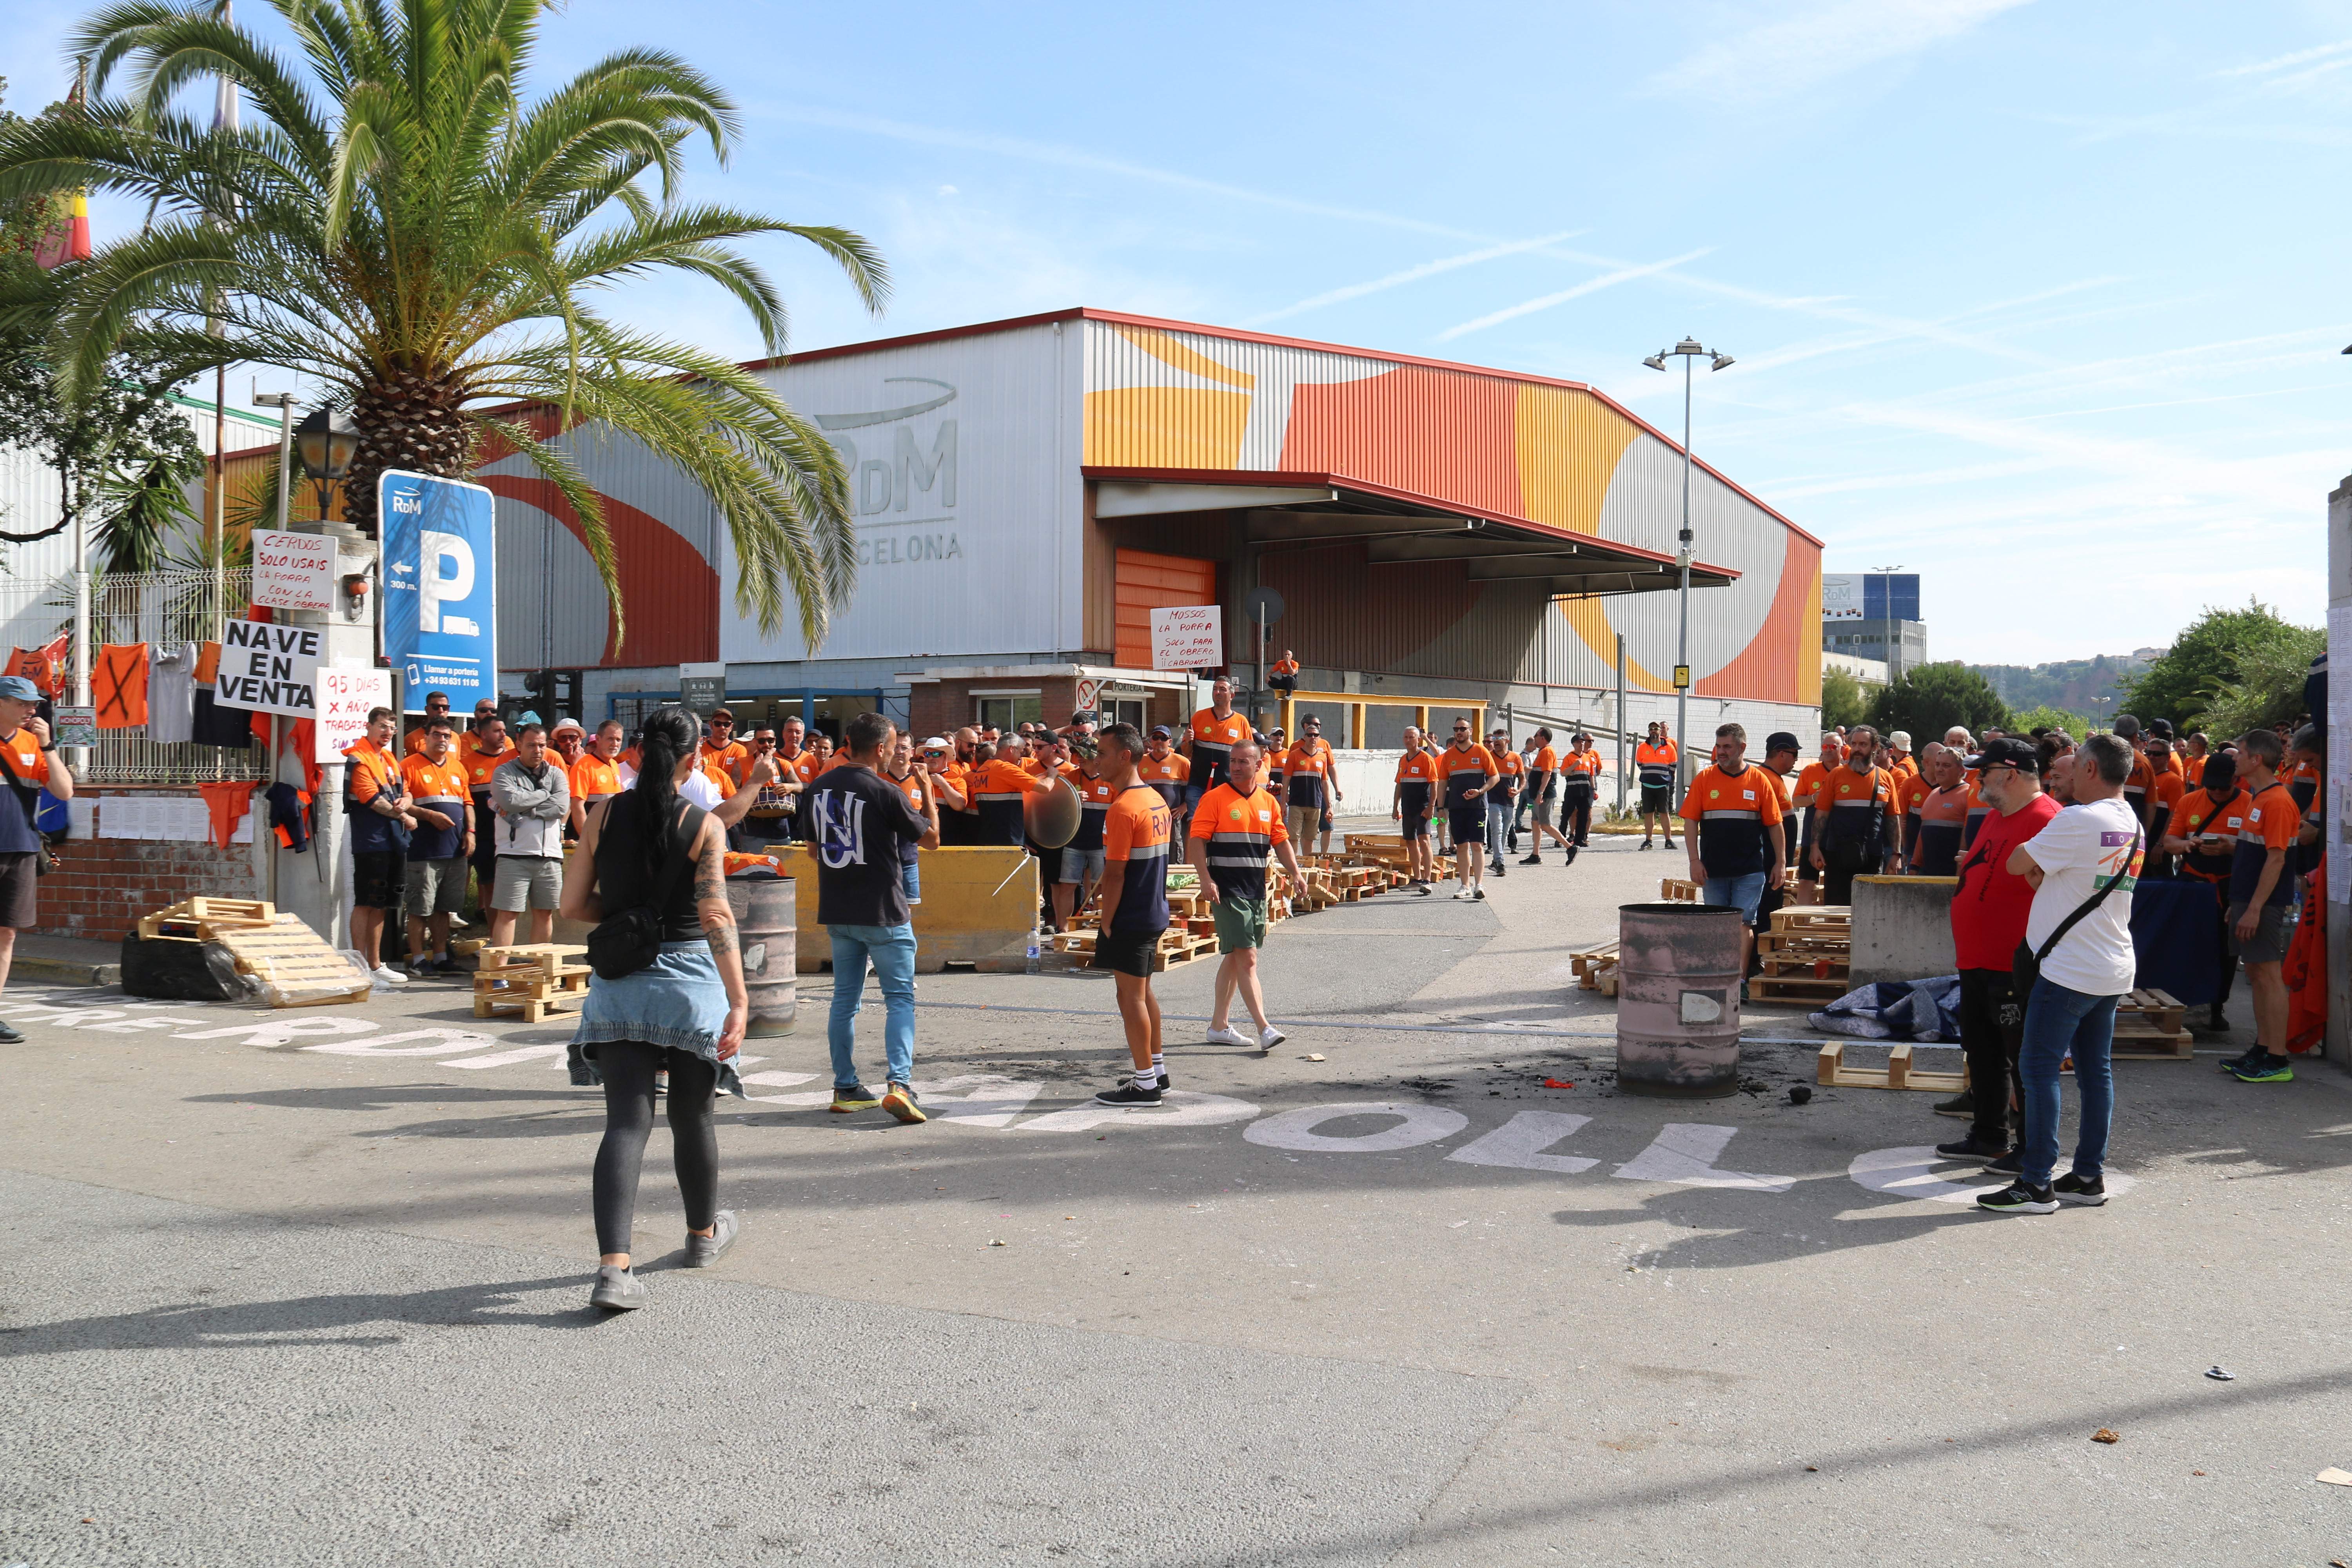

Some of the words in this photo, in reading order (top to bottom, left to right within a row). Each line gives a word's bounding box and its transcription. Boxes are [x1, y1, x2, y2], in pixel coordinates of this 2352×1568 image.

[263, 535, 323, 551] CERDOS
[857, 532, 962, 565] CELONA
[259, 552, 288, 566] SOLO
[259, 570, 270, 579] LA
[275, 572, 310, 584] PORRA
[420, 529, 475, 633] P
[269, 585, 293, 596] CON
[296, 590, 312, 598] LA
[390, 580, 405, 589] 300
[258, 595, 290, 606] CLASE
[294, 601, 330, 610] OBRERA
[1169, 610, 1206, 620] MOSSOS
[1180, 622, 1212, 632] PORRA
[227, 621, 319, 657] NAVE
[1165, 638, 1185, 647] SOLO
[1180, 648, 1214, 656] OBRERO
[249, 652, 292, 681] EN
[424, 664, 448, 674] Llamar
[327, 675, 348, 695] 95
[425, 676, 439, 684] +34
[439, 677, 448, 685] 93
[449, 677, 461, 686] 631
[470, 679, 479, 687] 06
[219, 674, 316, 710] VENTA
[345, 699, 370, 713] AÑO
